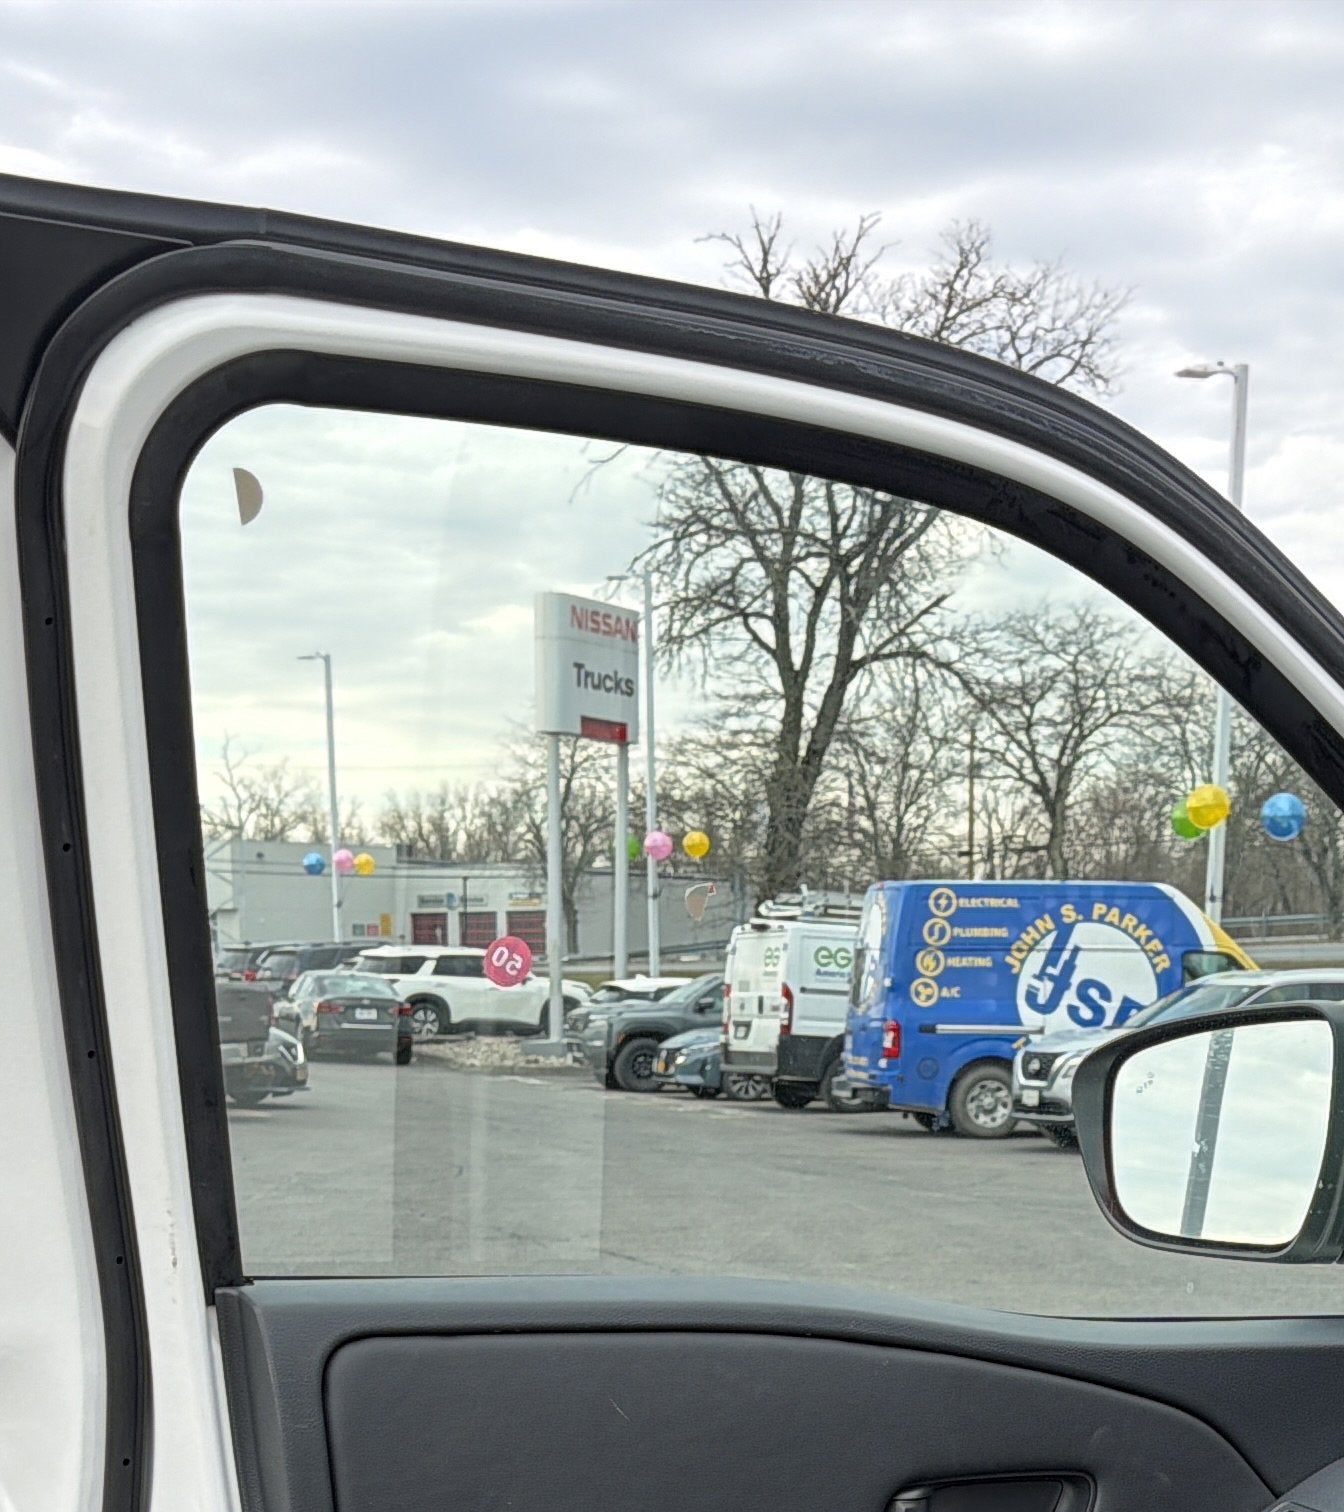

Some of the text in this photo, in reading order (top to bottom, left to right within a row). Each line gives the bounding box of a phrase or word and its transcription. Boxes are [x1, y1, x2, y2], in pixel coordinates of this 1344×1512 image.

[570, 605, 638, 642] NISSAN
[573, 662, 634, 698] Trucks
[958, 897, 1020, 908] ELECTRICAL
[1005, 902, 1171, 975] JOHN S. PARKER
